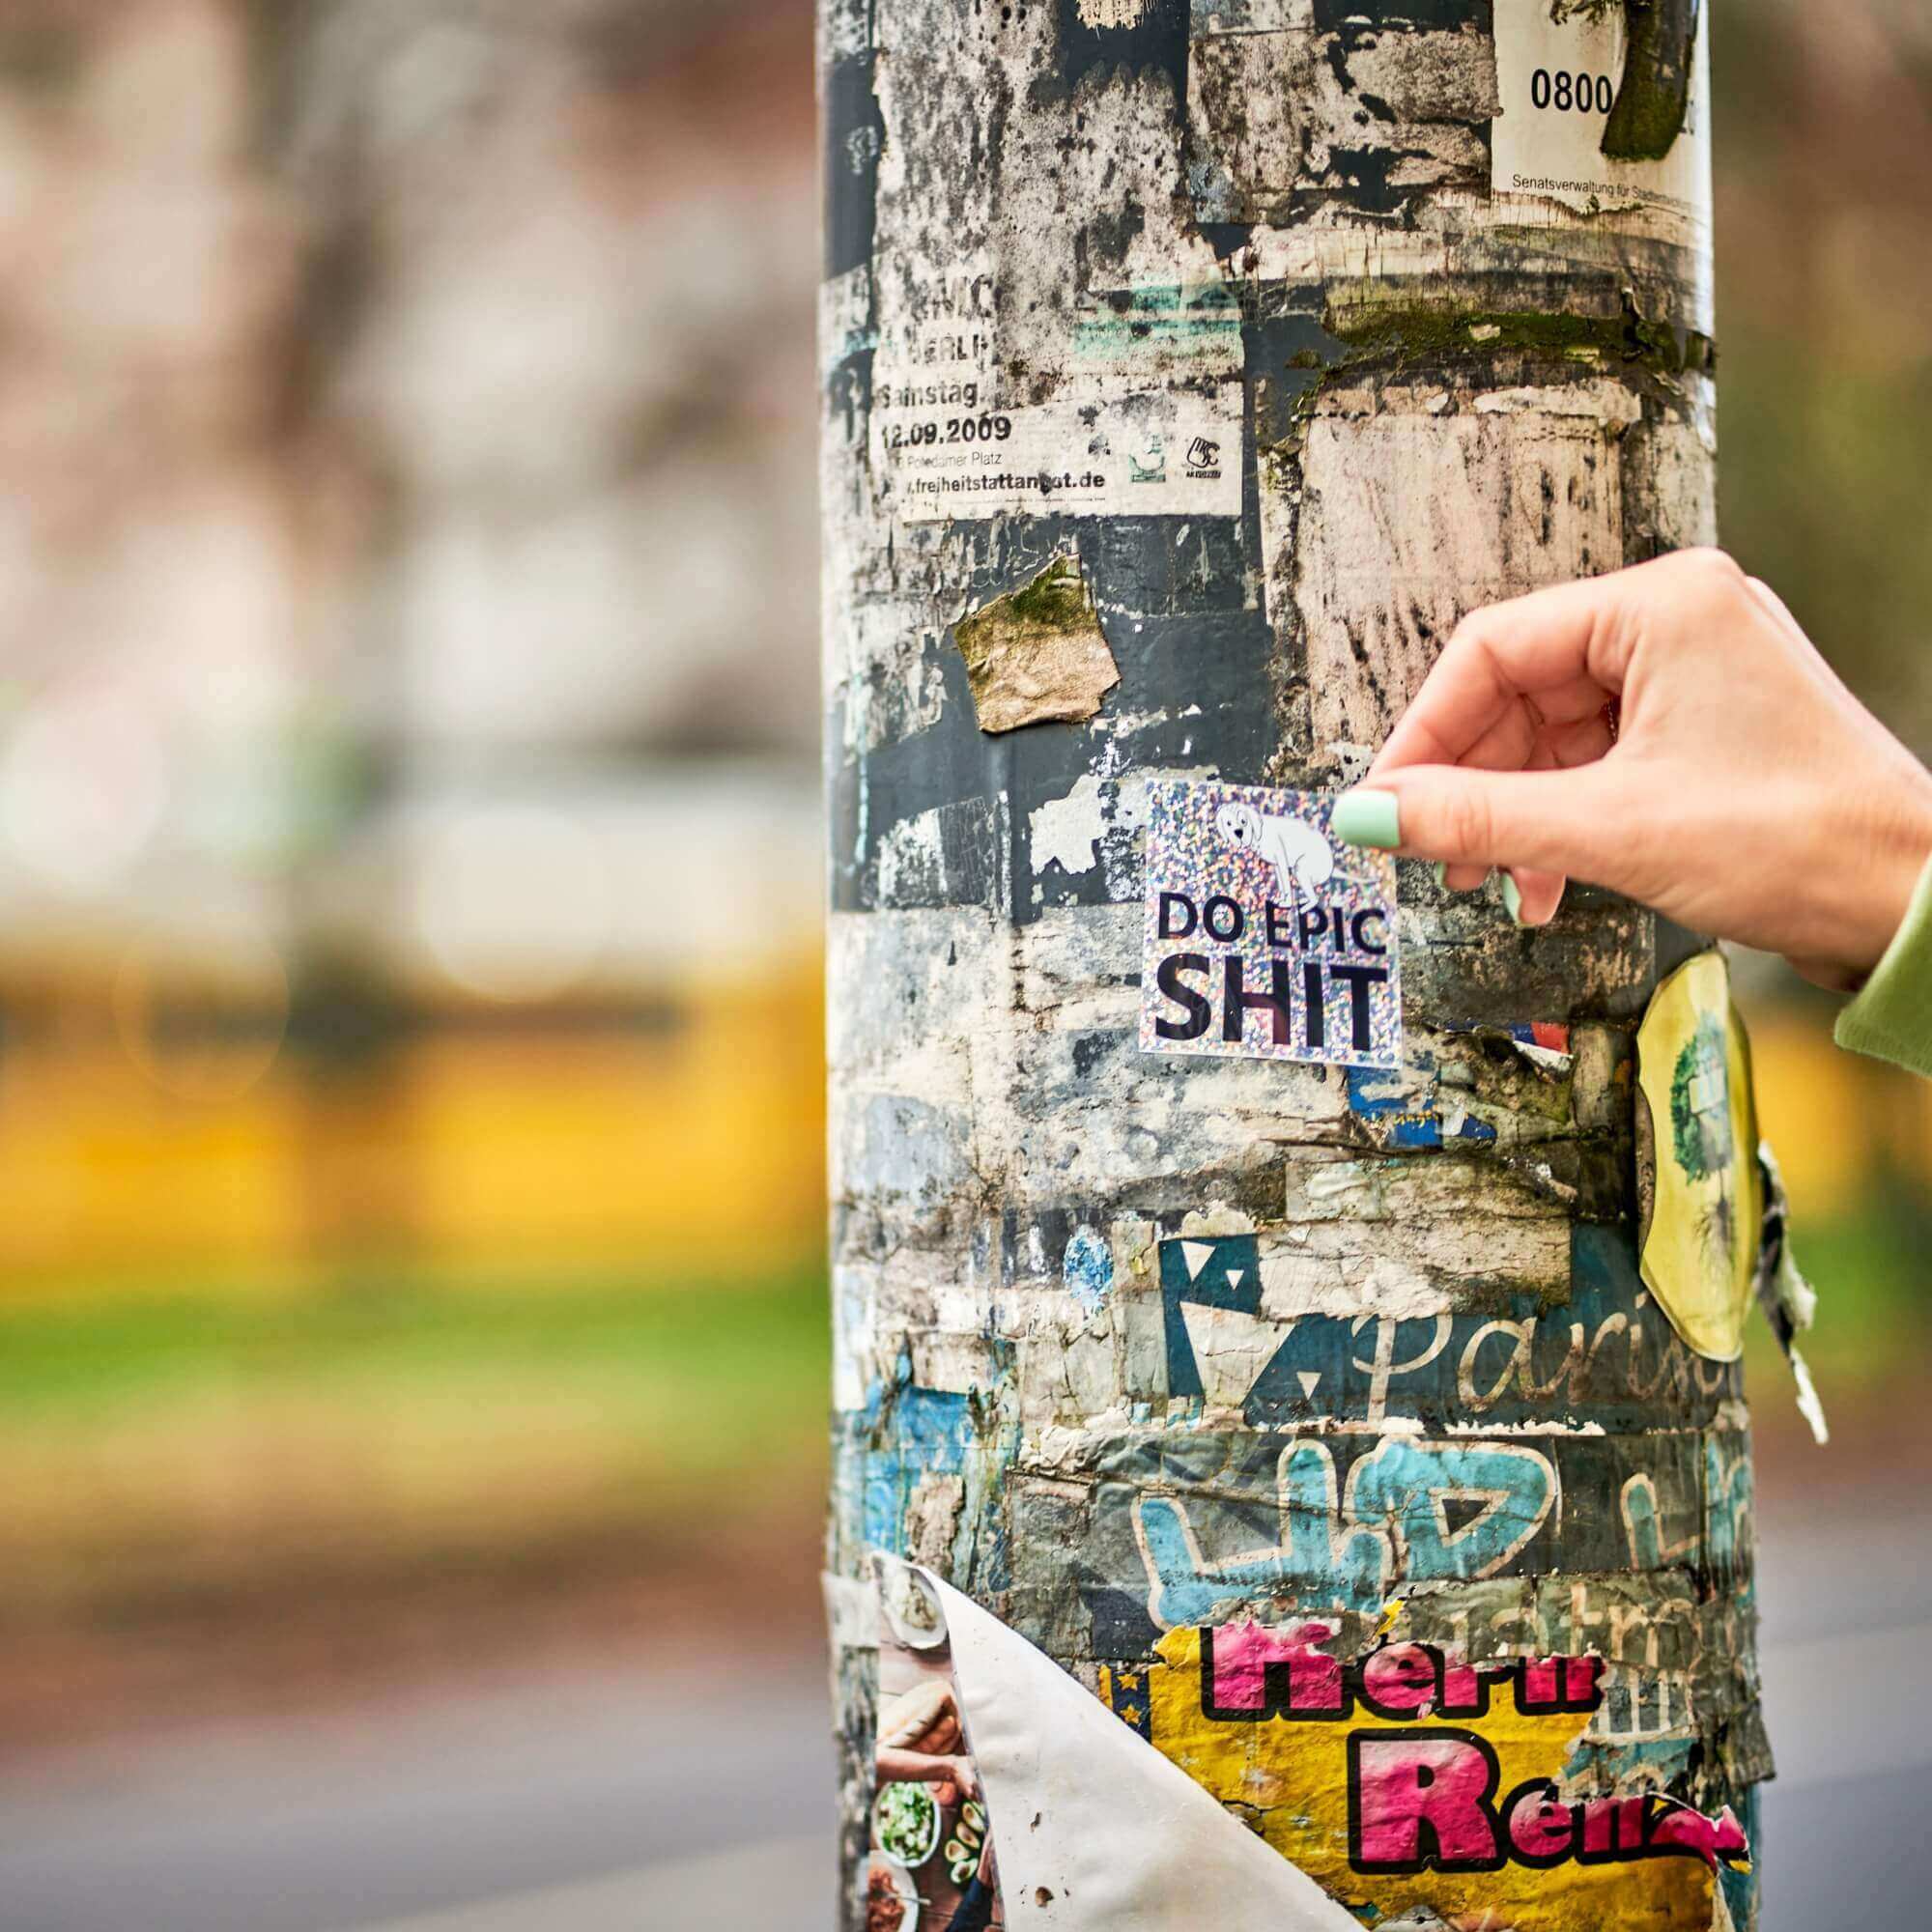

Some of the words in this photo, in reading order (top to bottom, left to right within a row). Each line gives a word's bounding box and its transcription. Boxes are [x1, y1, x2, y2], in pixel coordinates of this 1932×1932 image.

[1531, 69, 1612, 114] 0800
[1512, 174, 1614, 199] Senatsverwaltung
[972, 450, 1003, 466] Platz
[1158, 891, 1245, 943] DO
[1265, 900, 1387, 955] EPIC
[1155, 952, 1388, 1051] SHIT
